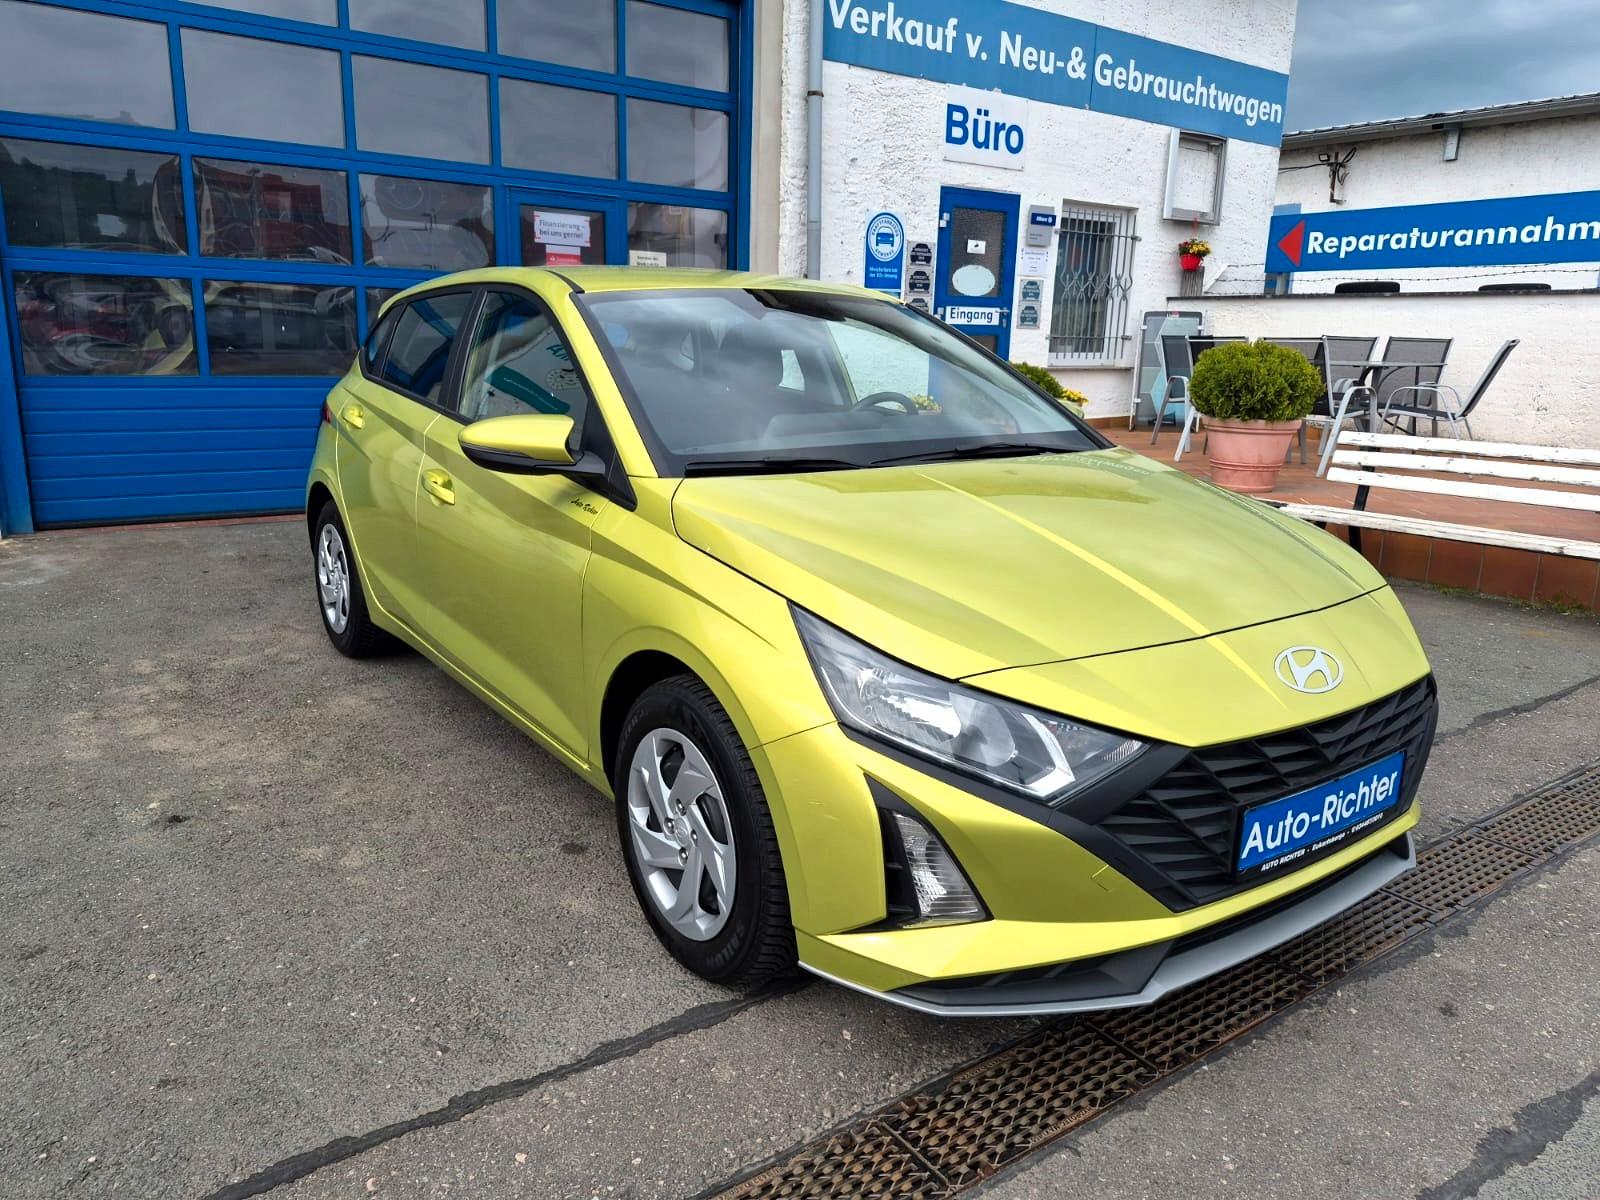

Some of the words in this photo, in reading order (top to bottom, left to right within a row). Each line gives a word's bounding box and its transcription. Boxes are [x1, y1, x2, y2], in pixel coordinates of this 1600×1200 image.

[828, 0, 957, 54] Verkauf
[966, 32, 988, 61] v.
[1094, 53, 1283, 128] Gebrauchtwagen
[945, 103, 1024, 155] Büro
[950, 306, 994, 323] Eingang
[1241, 771, 1398, 859] Auto-Richter
